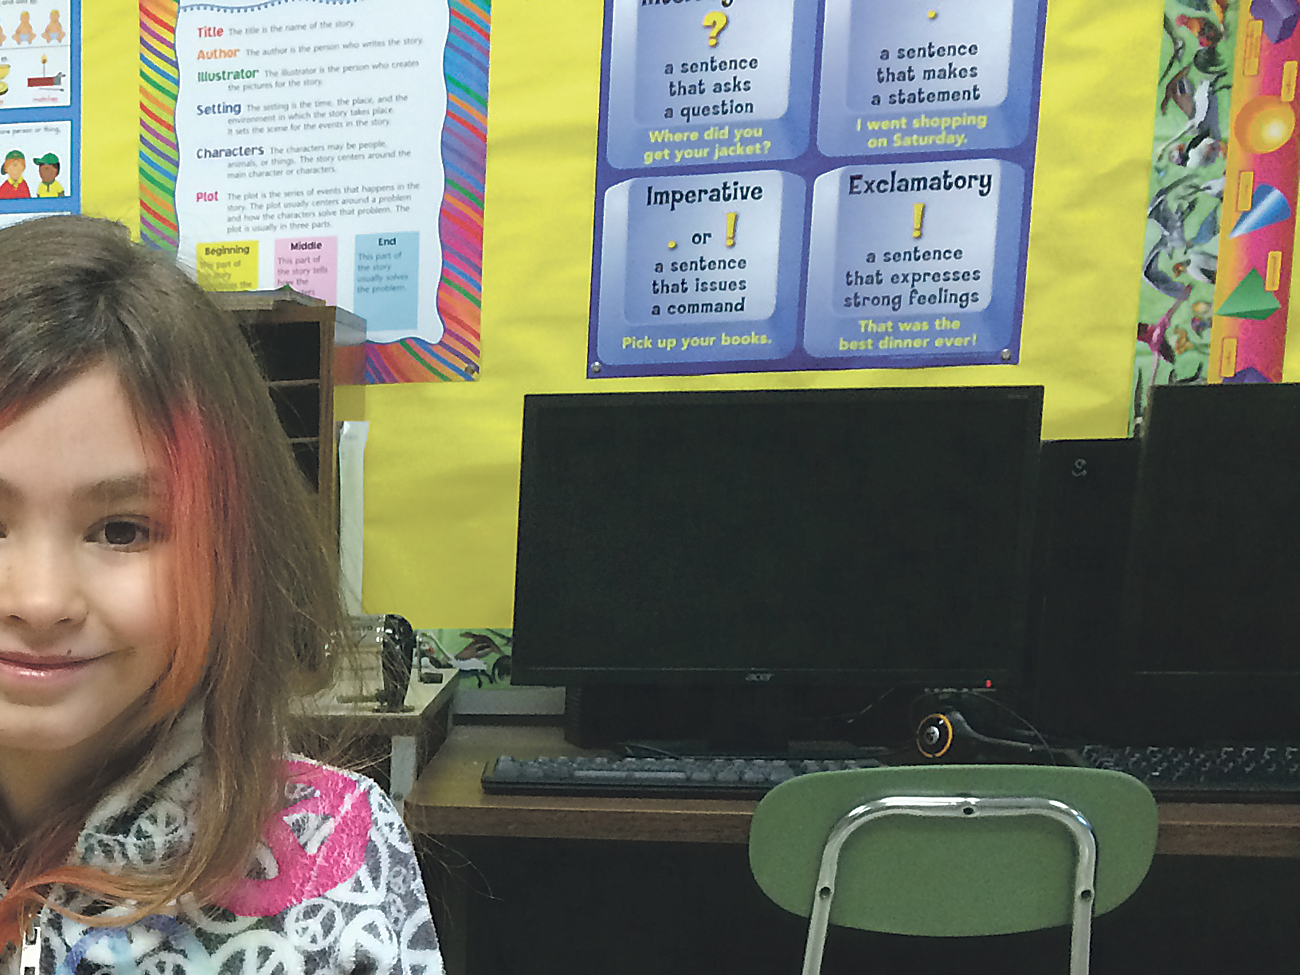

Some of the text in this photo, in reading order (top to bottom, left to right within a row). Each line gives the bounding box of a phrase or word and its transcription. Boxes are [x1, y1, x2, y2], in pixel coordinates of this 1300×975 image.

[197, 26, 224, 39] Title
[197, 48, 240, 61] Author
[879, 42, 979, 61] a sentence
[664, 56, 759, 75] a sentence
[877, 62, 978, 84] that makes
[197, 69, 260, 83] Illustrator
[669, 76, 751, 97] that asks
[871, 84, 981, 106] a statement
[197, 102, 242, 116] Setting
[664, 99, 754, 123] a question
[856, 113, 988, 132] I went shopping
[649, 126, 763, 143] Where did you
[868, 129, 969, 149] on Saturday.
[196, 145, 265, 159] Characters
[644, 140, 772, 165] get your jacket?
[849, 170, 993, 197] Exclamatory
[196, 191, 219, 203] Plot
[647, 181, 763, 212] Imperative
[290, 240, 323, 251] Middle
[378, 237, 397, 247] End
[692, 232, 712, 245] or
[205, 245, 250, 256] Beginning
[866, 246, 963, 264] a sentence
[654, 256, 747, 274] a sentence
[652, 278, 747, 295] that issues
[845, 269, 981, 288] that expresses
[652, 297, 746, 316] a command
[844, 287, 980, 312] strong feelings
[858, 317, 961, 333] That was the
[622, 331, 772, 351] Pick up your books.
[839, 333, 978, 351] best dinner ever!
[745, 673, 775, 682] acer
